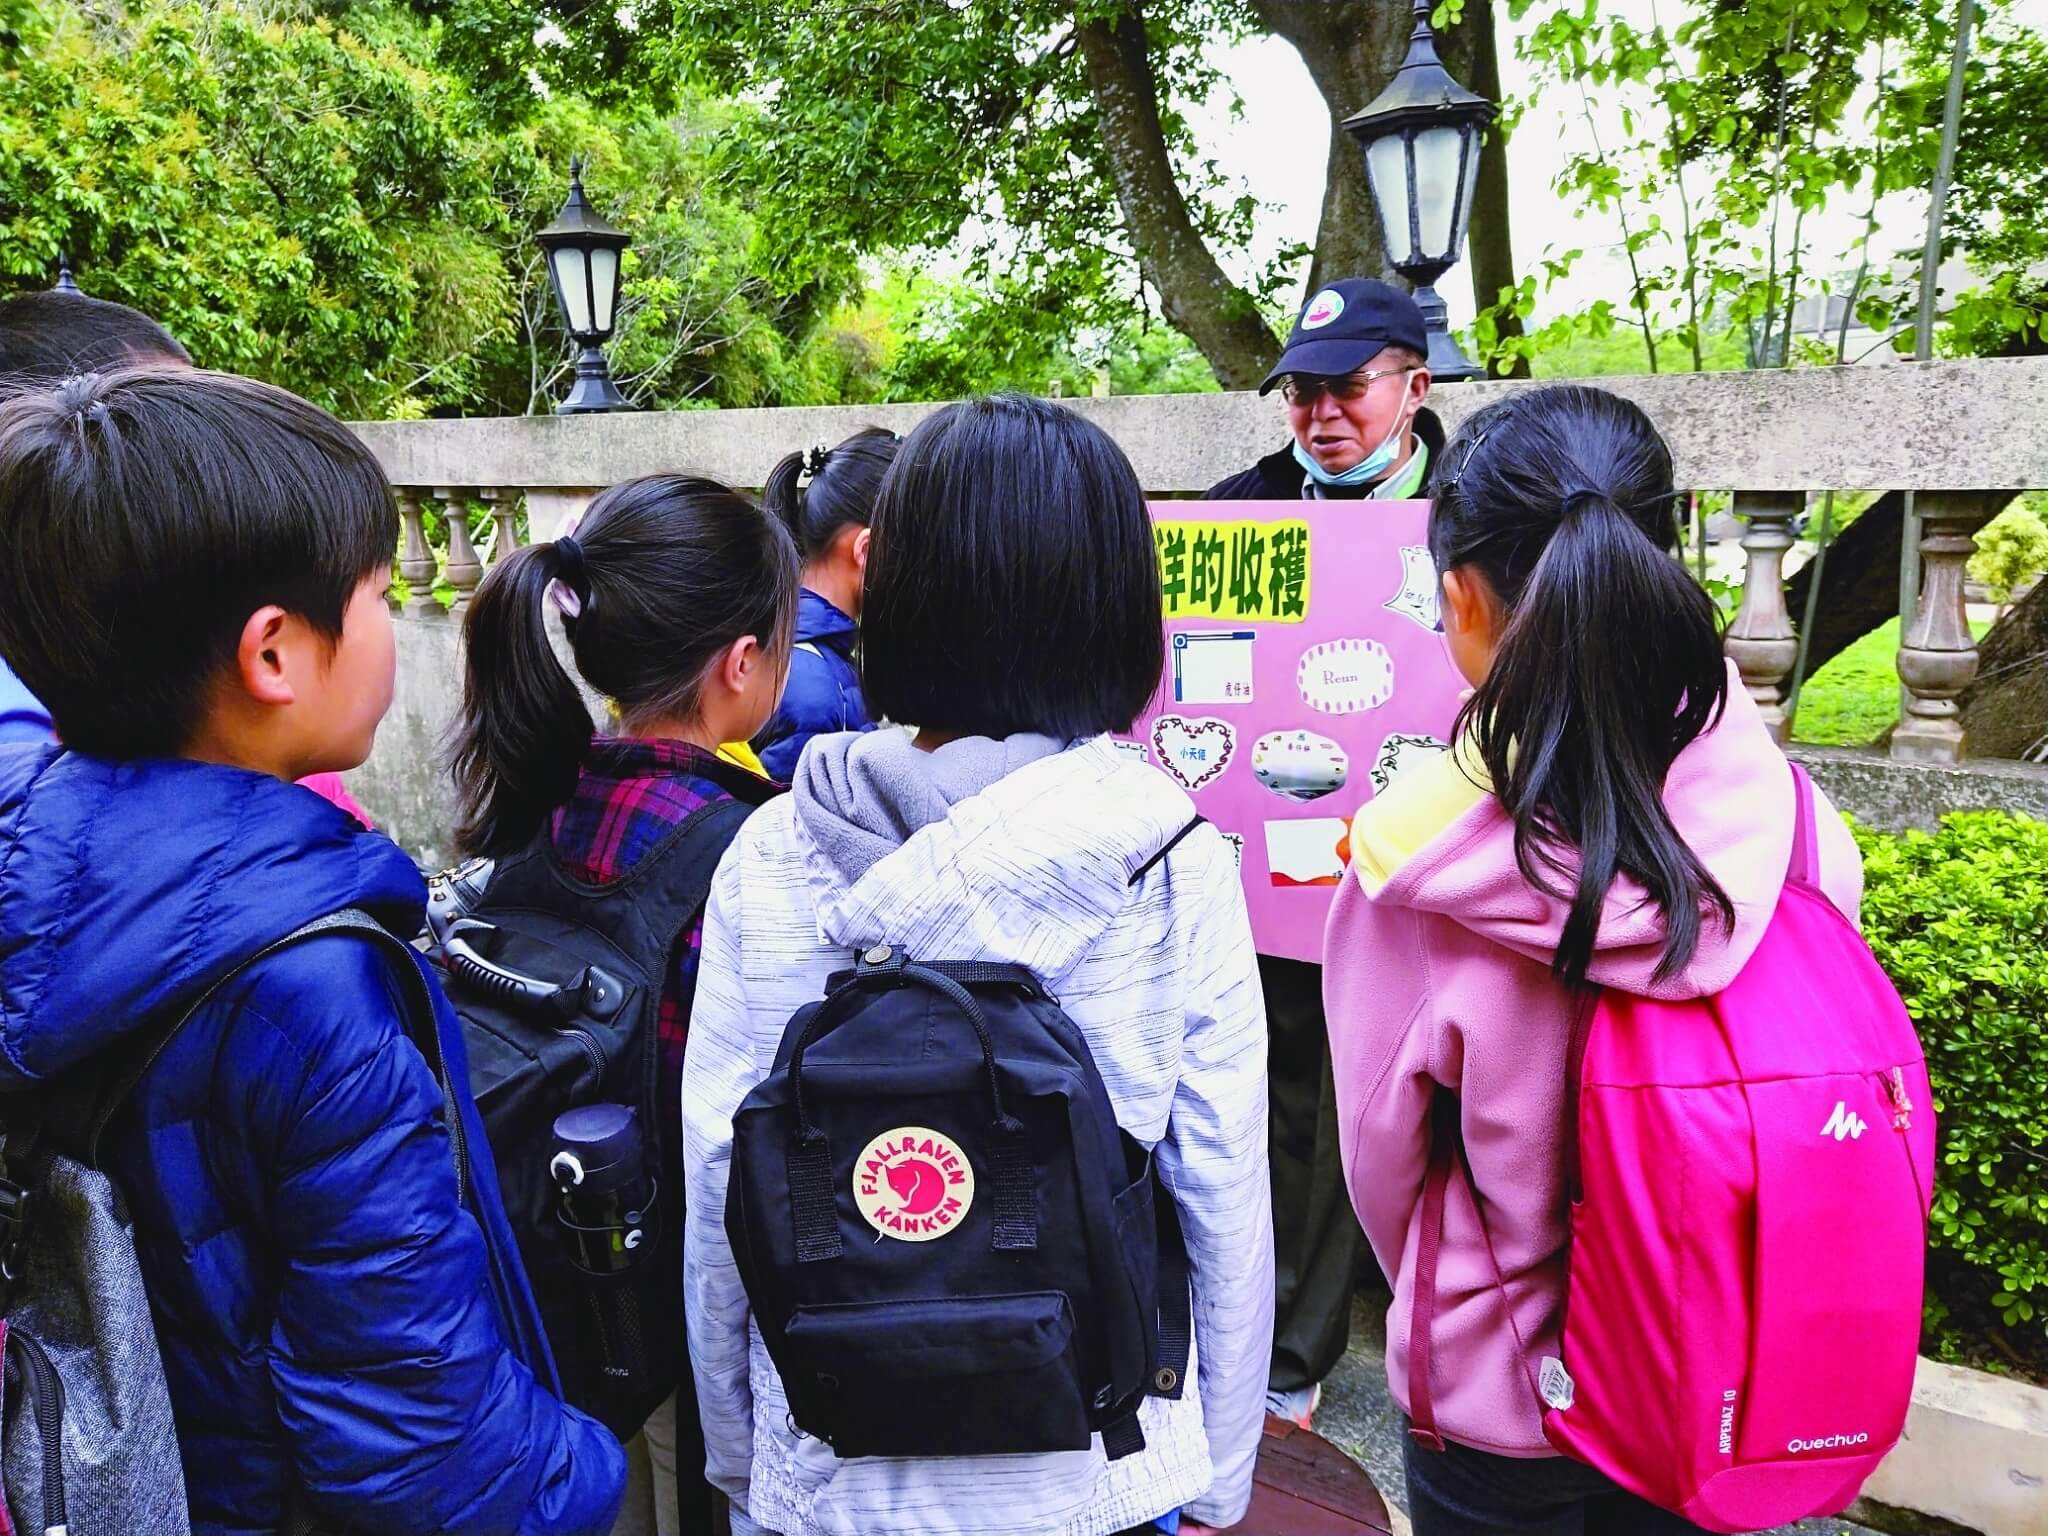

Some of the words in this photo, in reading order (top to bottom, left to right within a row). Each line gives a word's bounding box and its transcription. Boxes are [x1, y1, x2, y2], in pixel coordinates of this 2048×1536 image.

[1723, 1389, 1737, 1402] 10
[1719, 1404, 1734, 1454] ARPENAZ
[1787, 1432, 1869, 1454] Quechua
